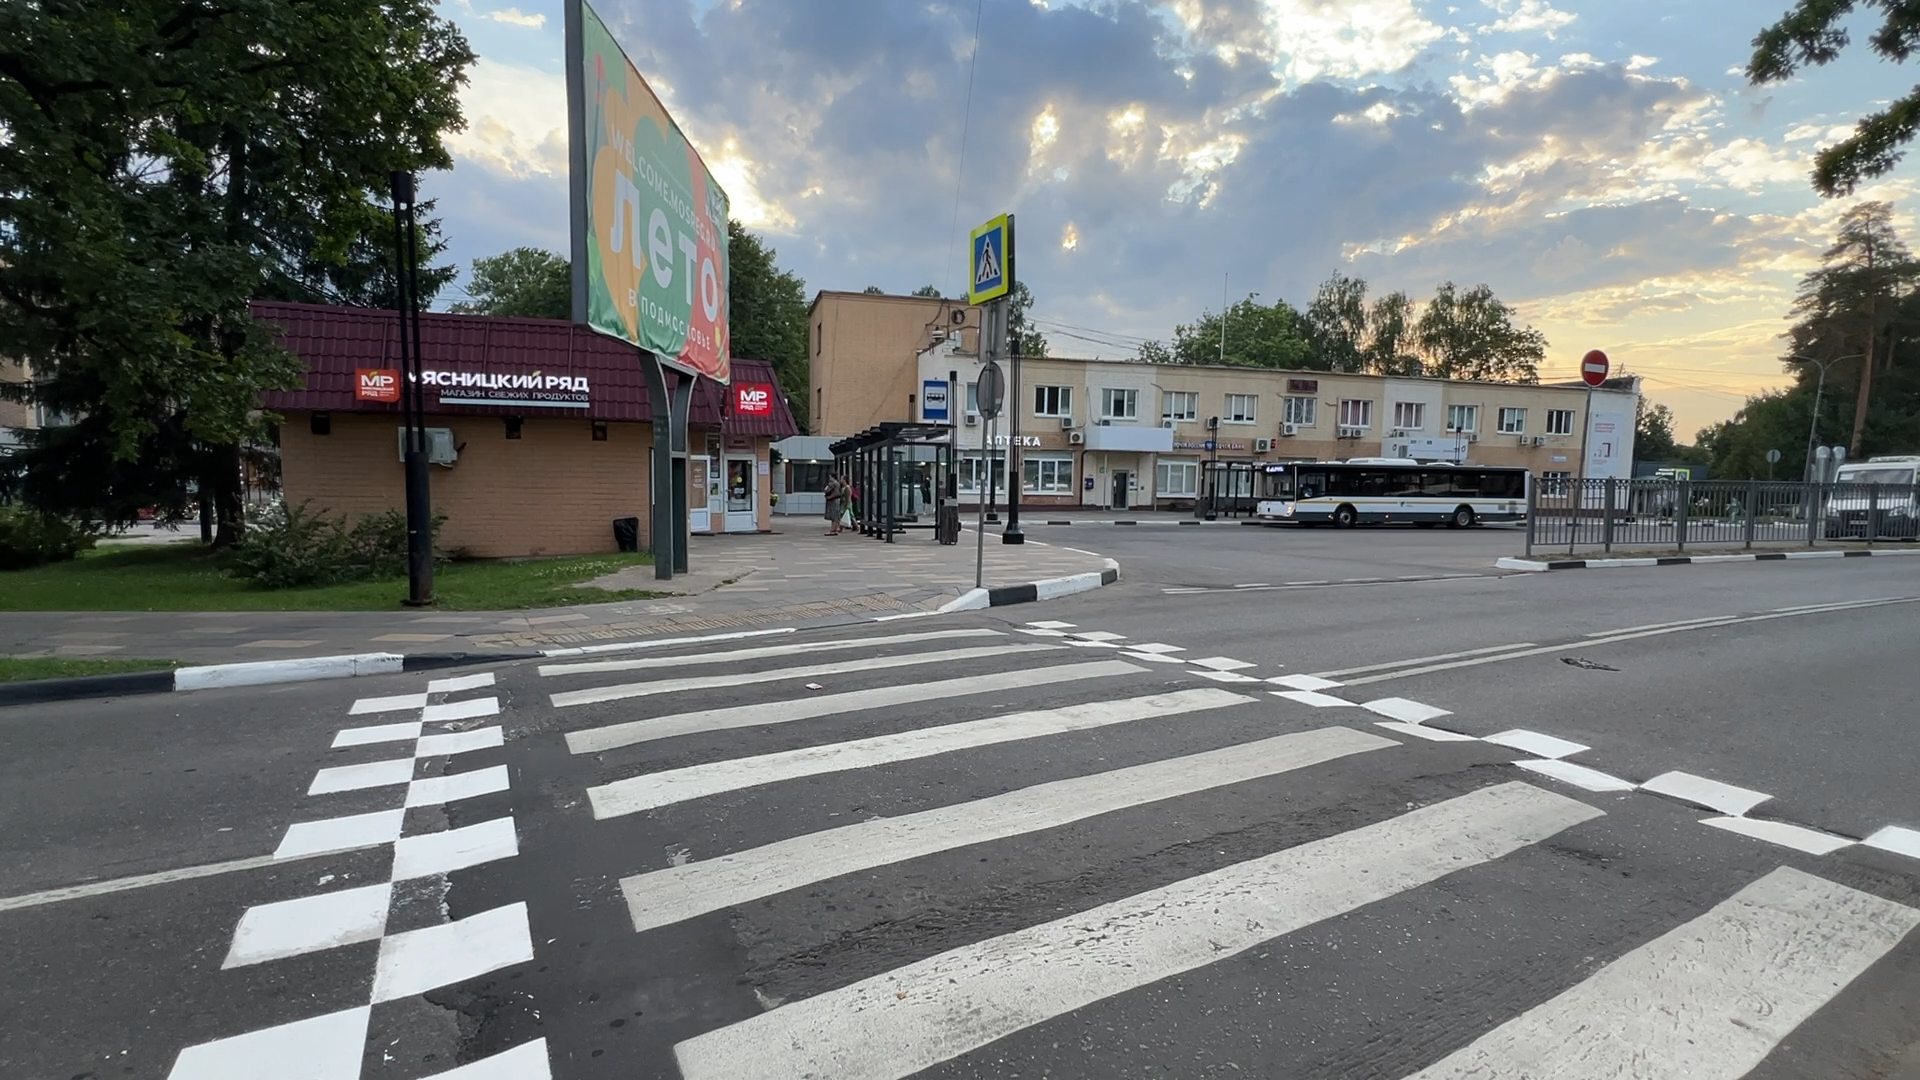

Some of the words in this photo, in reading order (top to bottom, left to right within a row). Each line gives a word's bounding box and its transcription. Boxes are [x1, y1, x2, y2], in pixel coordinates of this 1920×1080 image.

[545, 375, 590, 392] РЯД
[440, 389, 485, 398] МАГАЗИН
[488, 391, 529, 399] СВЕЖИХ
[532, 392, 589, 401] ПРОДУКТОВ
[986, 435, 1041, 447] АПТЕКА
